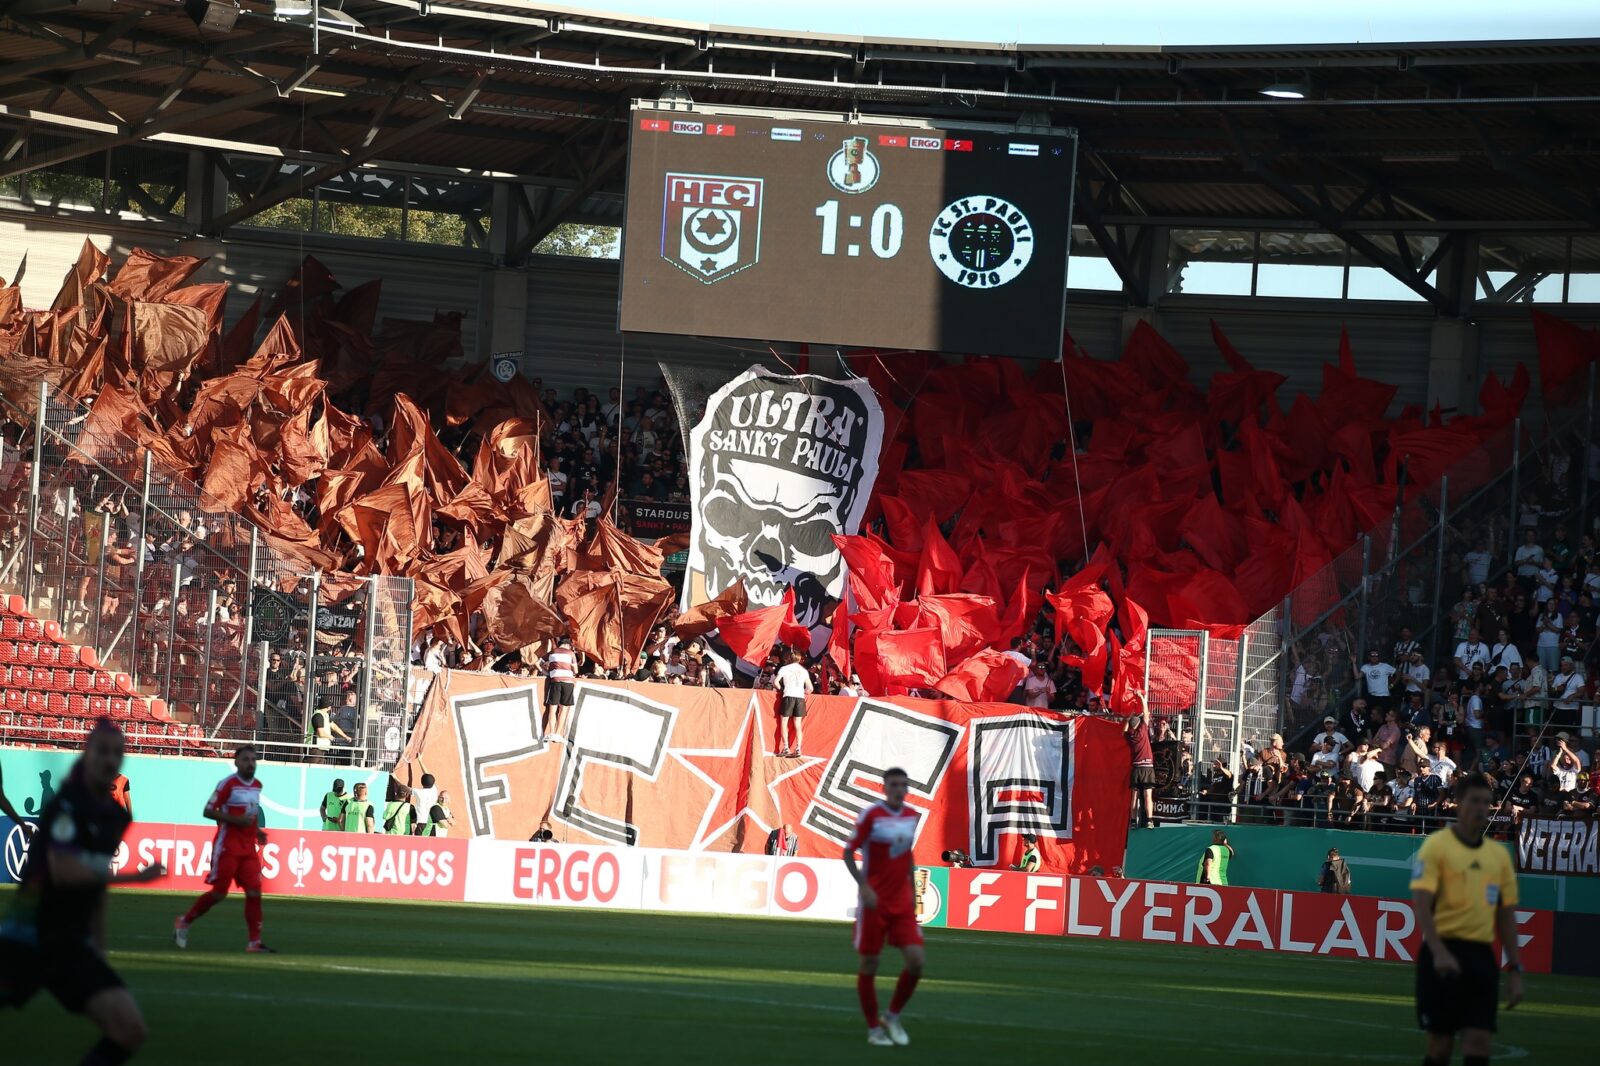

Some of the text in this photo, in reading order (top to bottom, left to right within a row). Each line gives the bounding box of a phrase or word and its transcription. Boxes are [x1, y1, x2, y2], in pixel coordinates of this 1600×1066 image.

[673, 123, 702, 132] ERGO
[911, 138, 940, 148] ERGO
[674, 181, 751, 206] HFC
[815, 200, 904, 258] 1:0
[957, 269, 1001, 286] 1910
[709, 429, 859, 483] SANKT PAULI
[636, 507, 690, 520] STARDUS
[450, 681, 1076, 867] FC SP
[1153, 801, 1184, 814] ÖMMA
[137, 838, 281, 879] STRAS
[319, 844, 454, 887] STRAUSS
[1519, 818, 1599, 873] VETERA
[512, 847, 621, 903] ERGO
[1024, 875, 1425, 963] FLYERALAR
